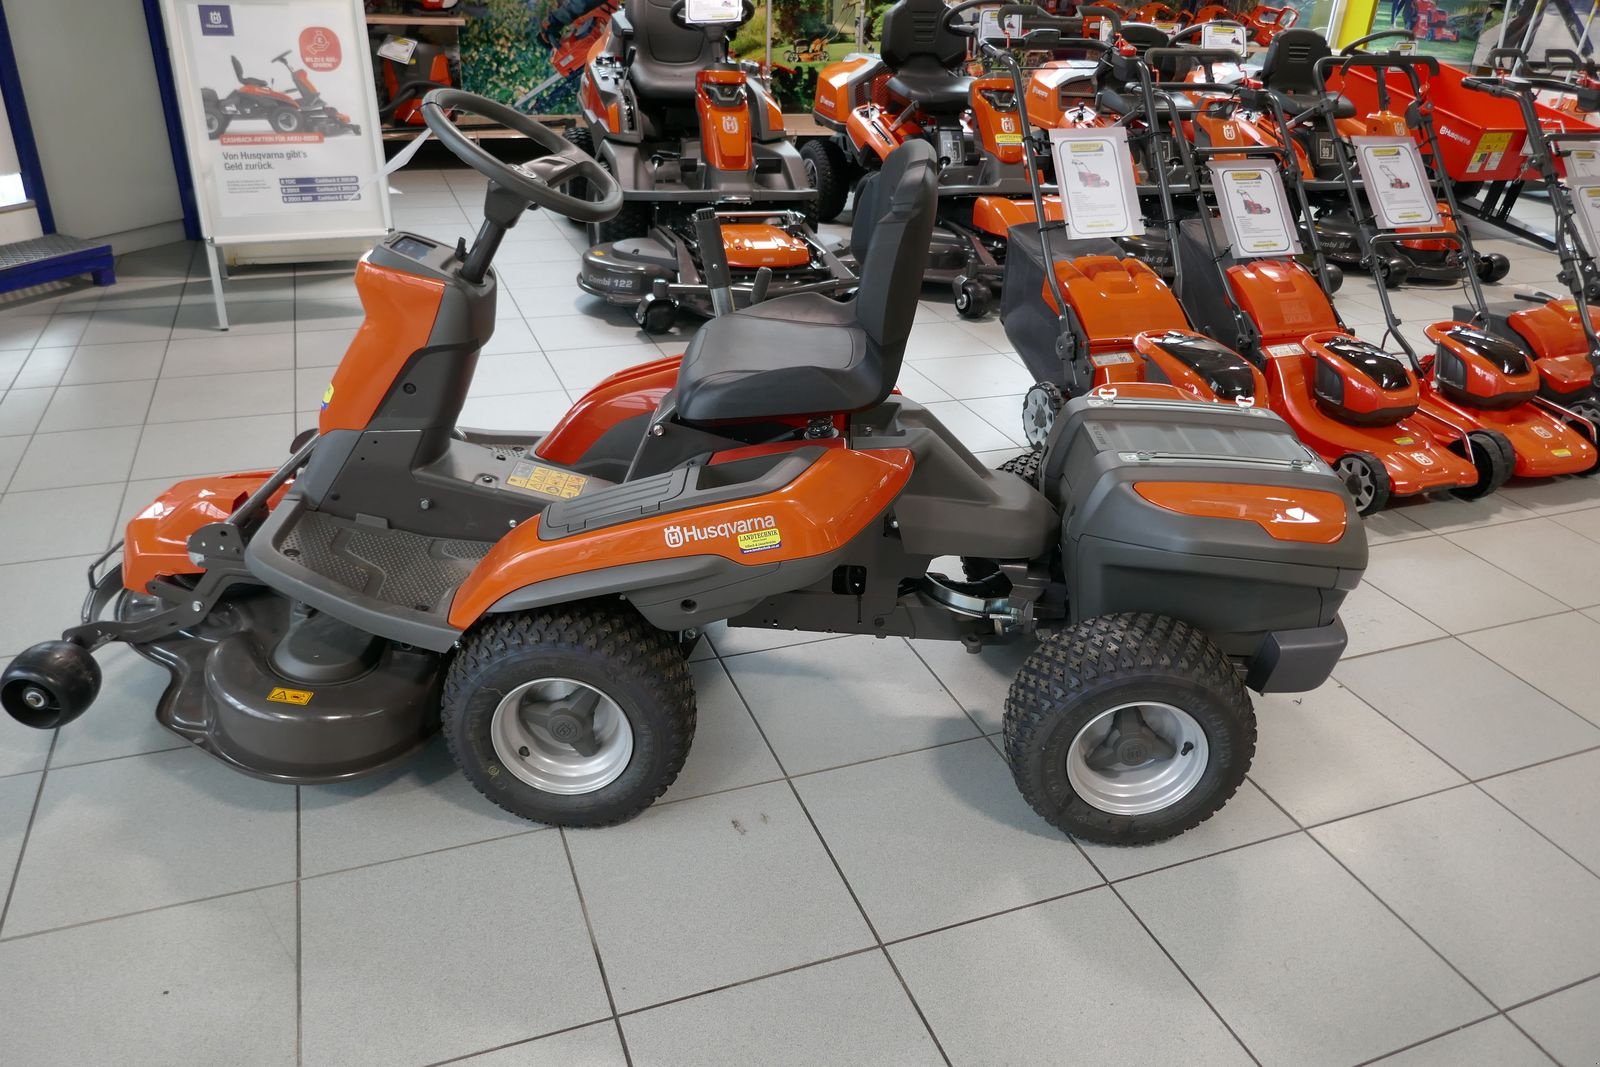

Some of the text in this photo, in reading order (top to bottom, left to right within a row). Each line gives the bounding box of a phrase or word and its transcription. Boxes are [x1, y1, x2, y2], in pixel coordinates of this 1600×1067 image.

[222, 150, 307, 161] Von Husqvarna gibt's
[224, 161, 275, 171] Geld zurück.
[589, 275, 633, 288] Combi 122
[684, 515, 775, 542] Husqvarna
[739, 530, 778, 541] LANDTECHNIK
